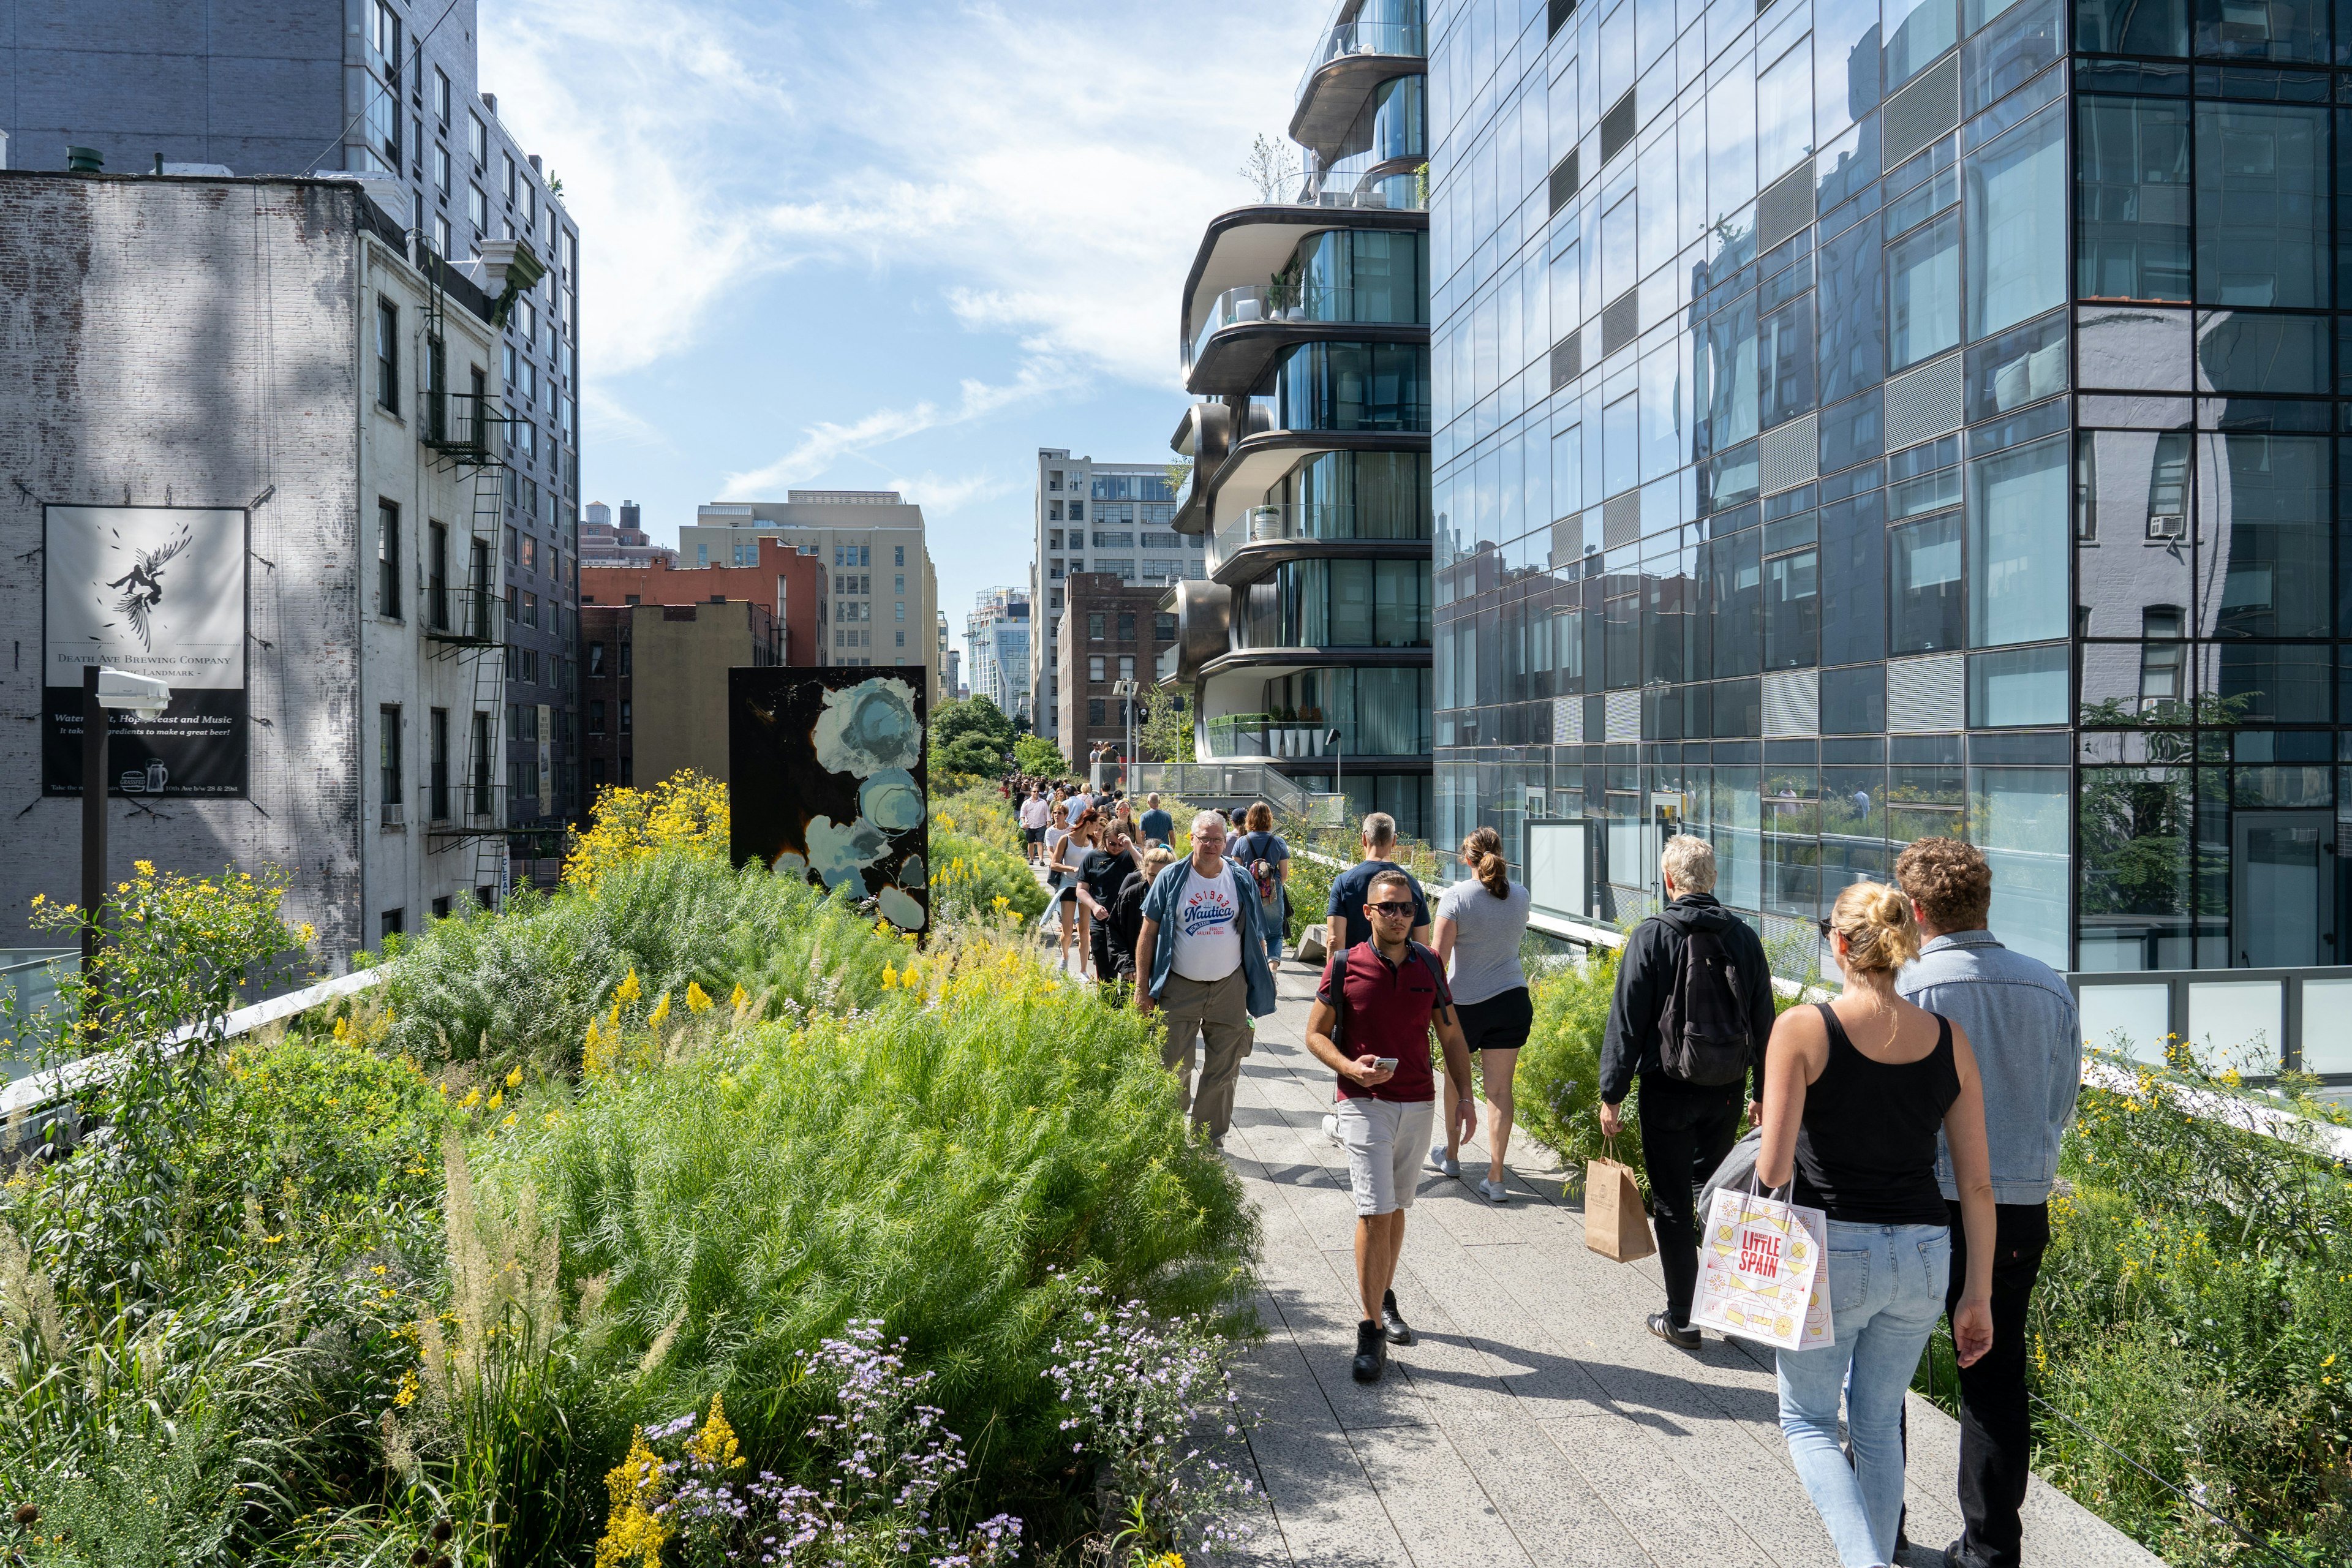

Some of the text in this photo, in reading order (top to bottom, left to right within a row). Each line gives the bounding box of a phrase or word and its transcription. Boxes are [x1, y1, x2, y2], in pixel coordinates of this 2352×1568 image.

[1189, 891, 1230, 908] NS1983
[1185, 905, 1232, 922] Nautica
[1742, 1230, 1781, 1257] LITTLE
[1739, 1250, 1779, 1278] SPAIN
